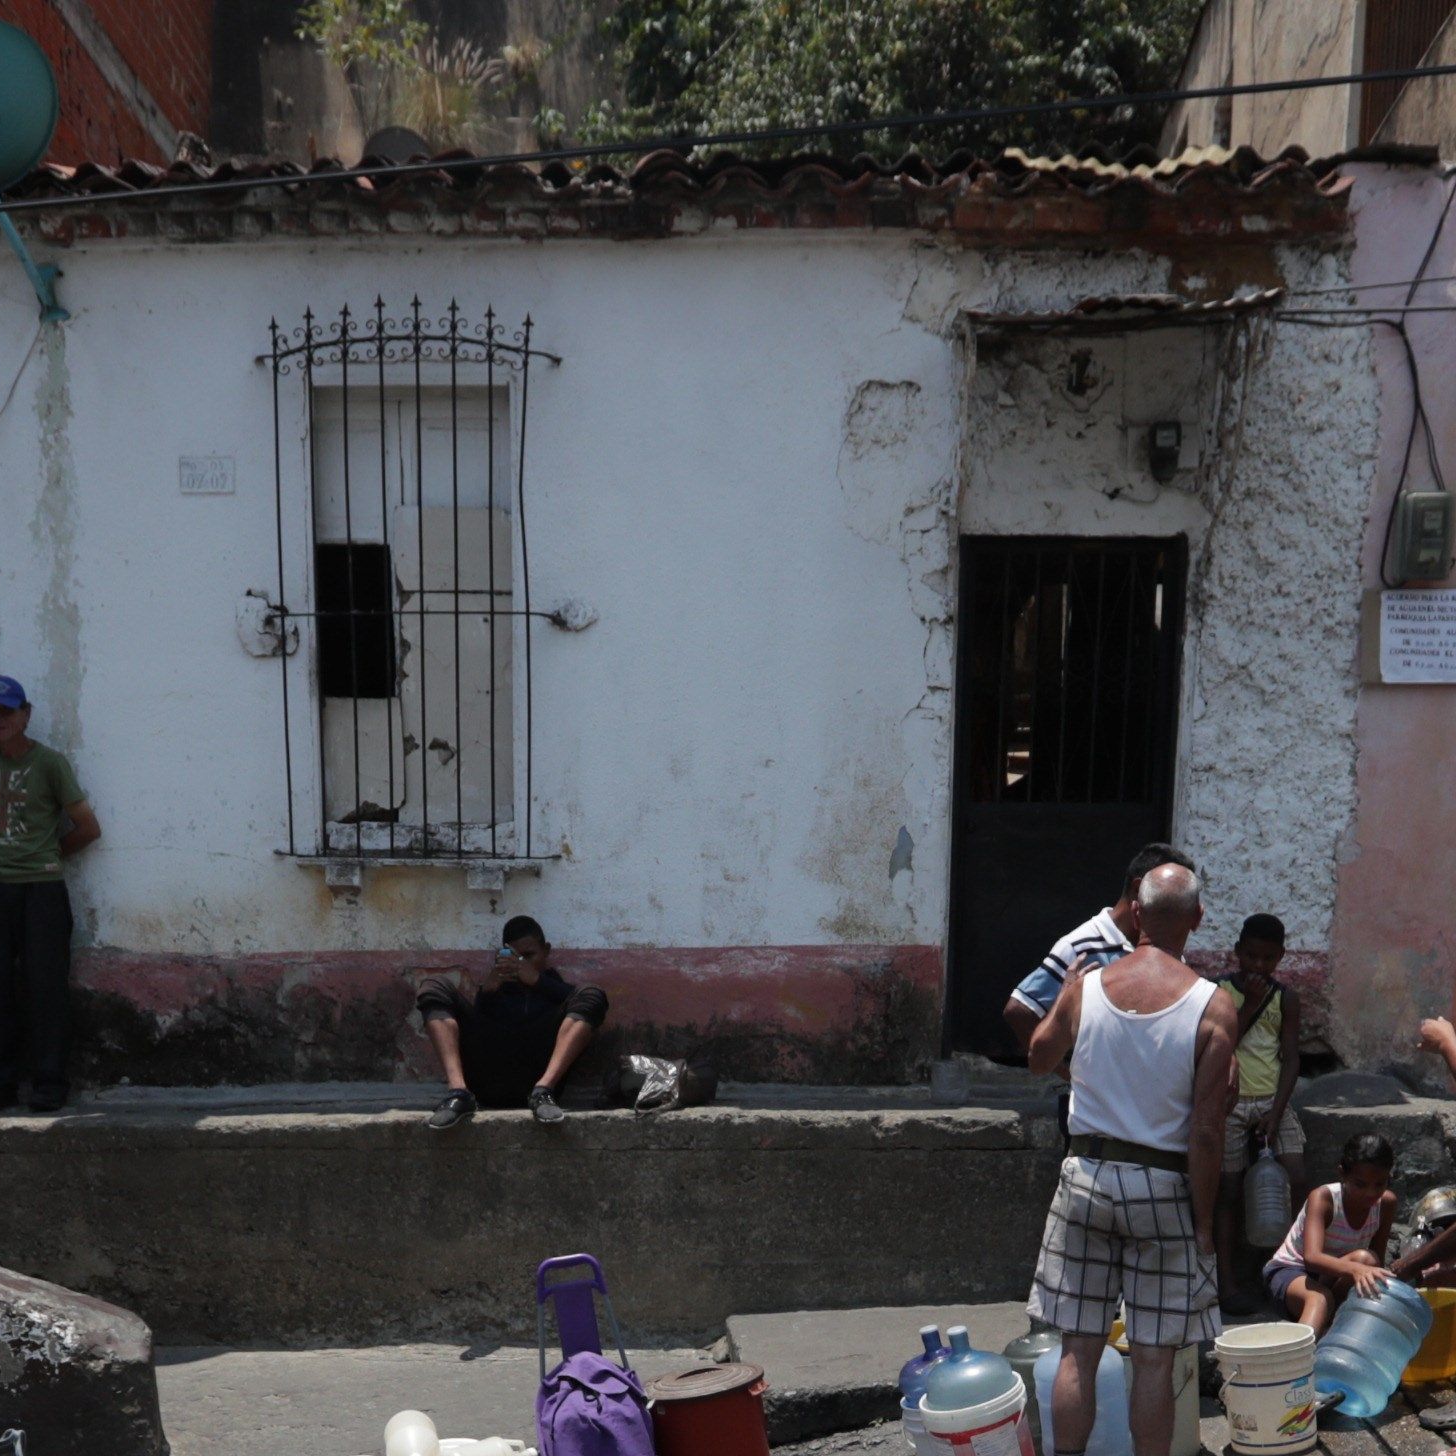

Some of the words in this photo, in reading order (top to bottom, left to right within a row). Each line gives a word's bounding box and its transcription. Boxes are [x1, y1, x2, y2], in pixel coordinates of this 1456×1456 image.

[1421, 594, 1438, 602] PARA
[1440, 594, 1450, 602] LA
[1390, 627, 1441, 635] COMUNIDADES
